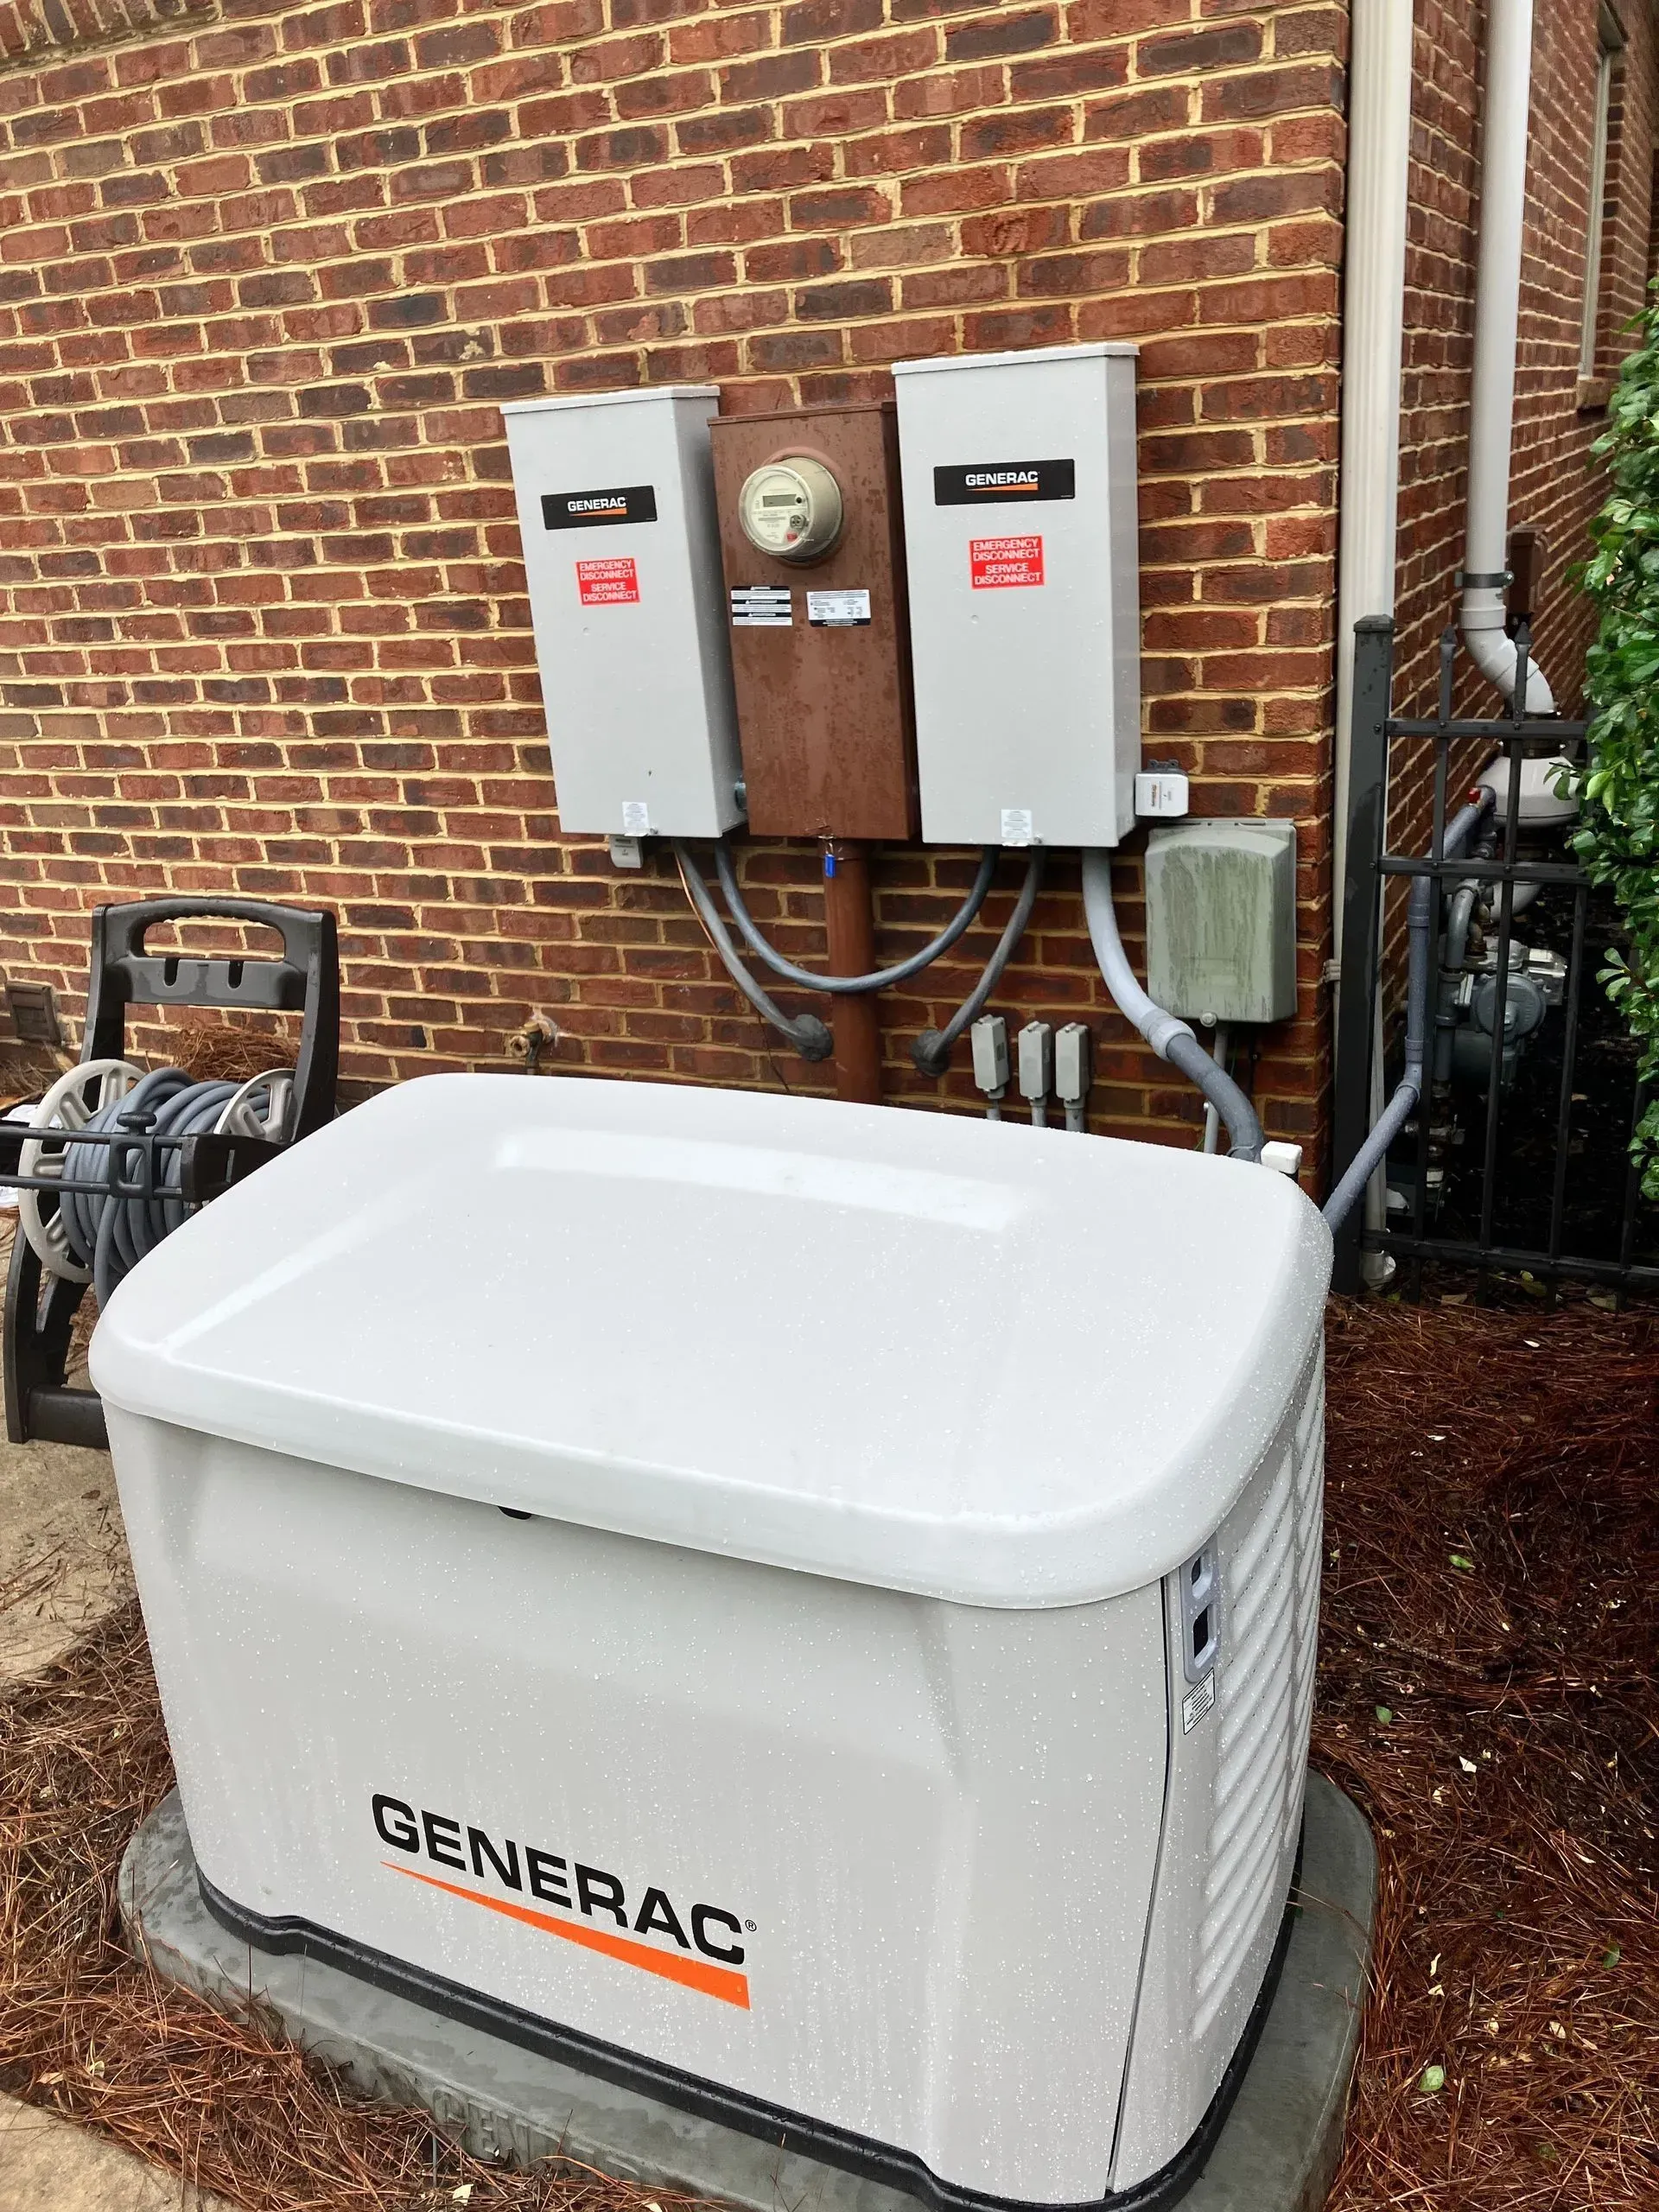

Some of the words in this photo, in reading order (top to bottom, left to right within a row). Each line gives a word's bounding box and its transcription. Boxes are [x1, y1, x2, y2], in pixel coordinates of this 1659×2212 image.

[965, 471, 1038, 486] GENERAC
[567, 497, 626, 512] GENERAC
[973, 538, 1038, 551] EMERGENCY
[972, 549, 1039, 562] DISCONNECT
[580, 560, 632, 571] EMERGENCY
[985, 563, 1029, 575] SERVICE
[580, 569, 634, 581] DISCONNECT
[975, 572, 1041, 585] DISCONNECT
[590, 582, 626, 592] SERVICE
[582, 590, 637, 602] DISCONNECT
